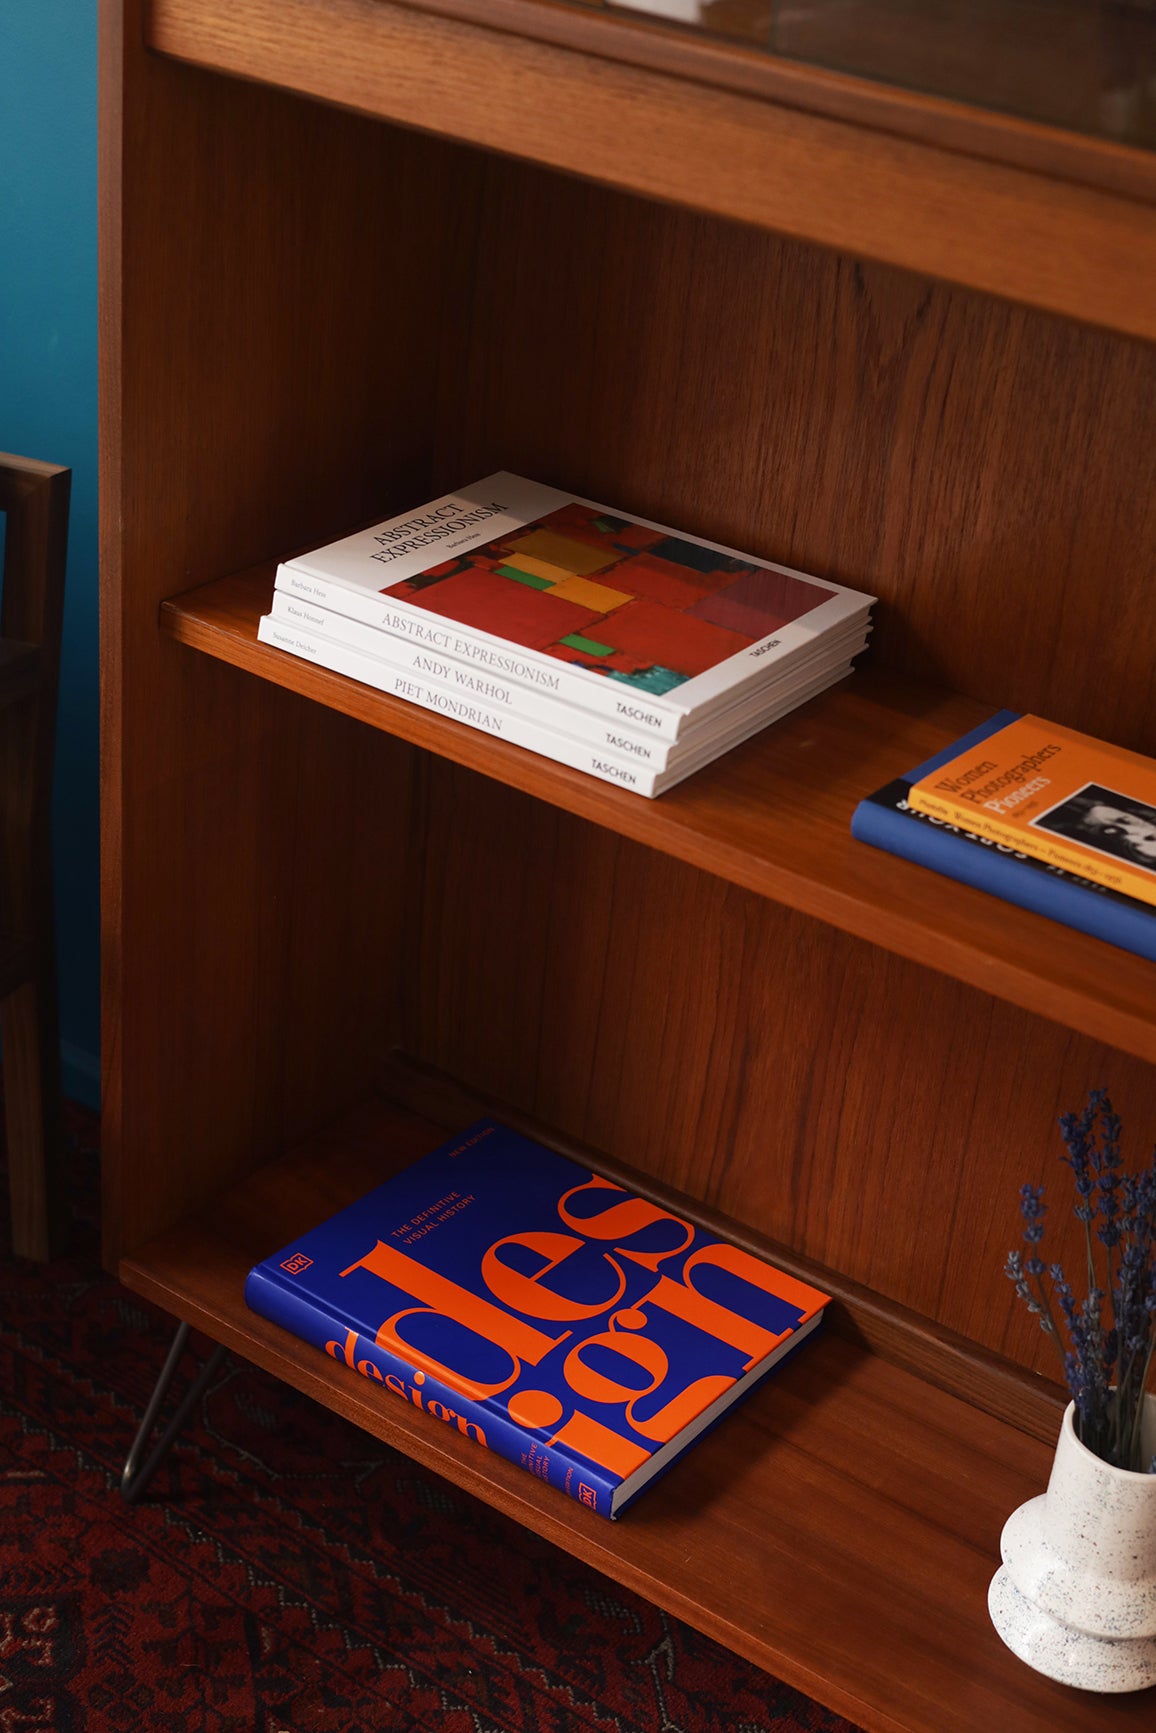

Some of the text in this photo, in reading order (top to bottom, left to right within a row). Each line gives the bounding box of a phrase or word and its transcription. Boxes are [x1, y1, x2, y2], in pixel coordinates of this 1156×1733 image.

[370, 502, 509, 563] EXPRESSIONISM
[373, 503, 464, 546] ABSTRACT
[382, 613, 561, 691] ABSTRACT EXPRESSIONISM
[749, 639, 782, 657] TASCHEN
[412, 655, 513, 705] ANDY WARHOL
[394, 678, 503, 731] PIET MONDRIAN
[616, 702, 662, 728] TASCHEN
[606, 732, 652, 758] TASCHEN
[592, 758, 636, 784] TASCHEN
[933, 760, 998, 793] Women
[960, 744, 1062, 804] Photographers
[983, 776, 1052, 815] Pioneers
[391, 1191, 461, 1238] THE DEFINITIVE
[402, 1194, 475, 1245] VISUAL HISTORY
[339, 1173, 695, 1401] des
